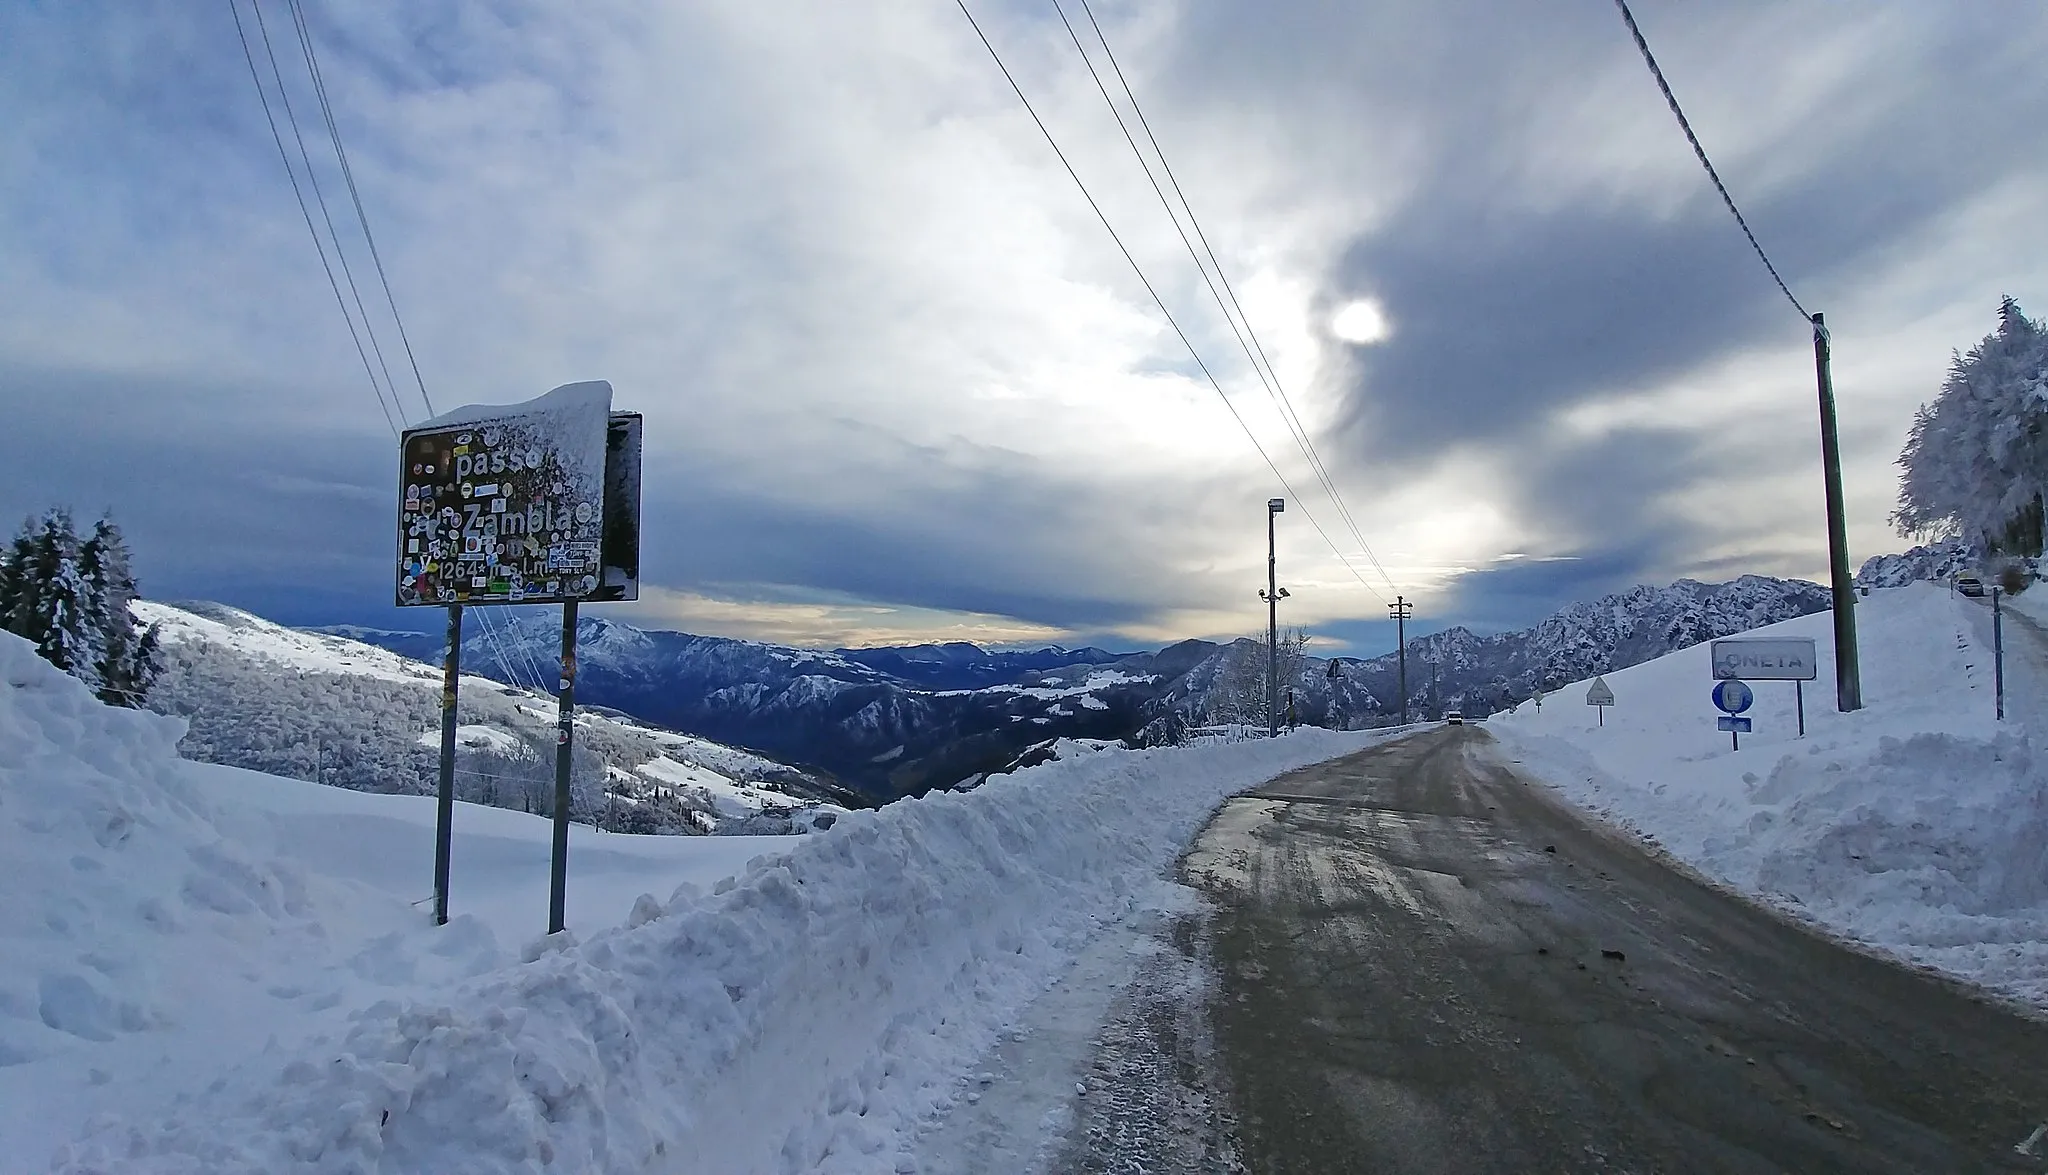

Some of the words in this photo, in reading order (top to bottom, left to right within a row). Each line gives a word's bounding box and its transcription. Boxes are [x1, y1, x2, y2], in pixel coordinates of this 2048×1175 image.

[456, 449, 541, 485] passo
[462, 500, 572, 538] Zambla
[438, 561, 478, 580] 1264
[490, 557, 553, 578] ms.l.m.
[1725, 653, 1802, 668] ONETA
